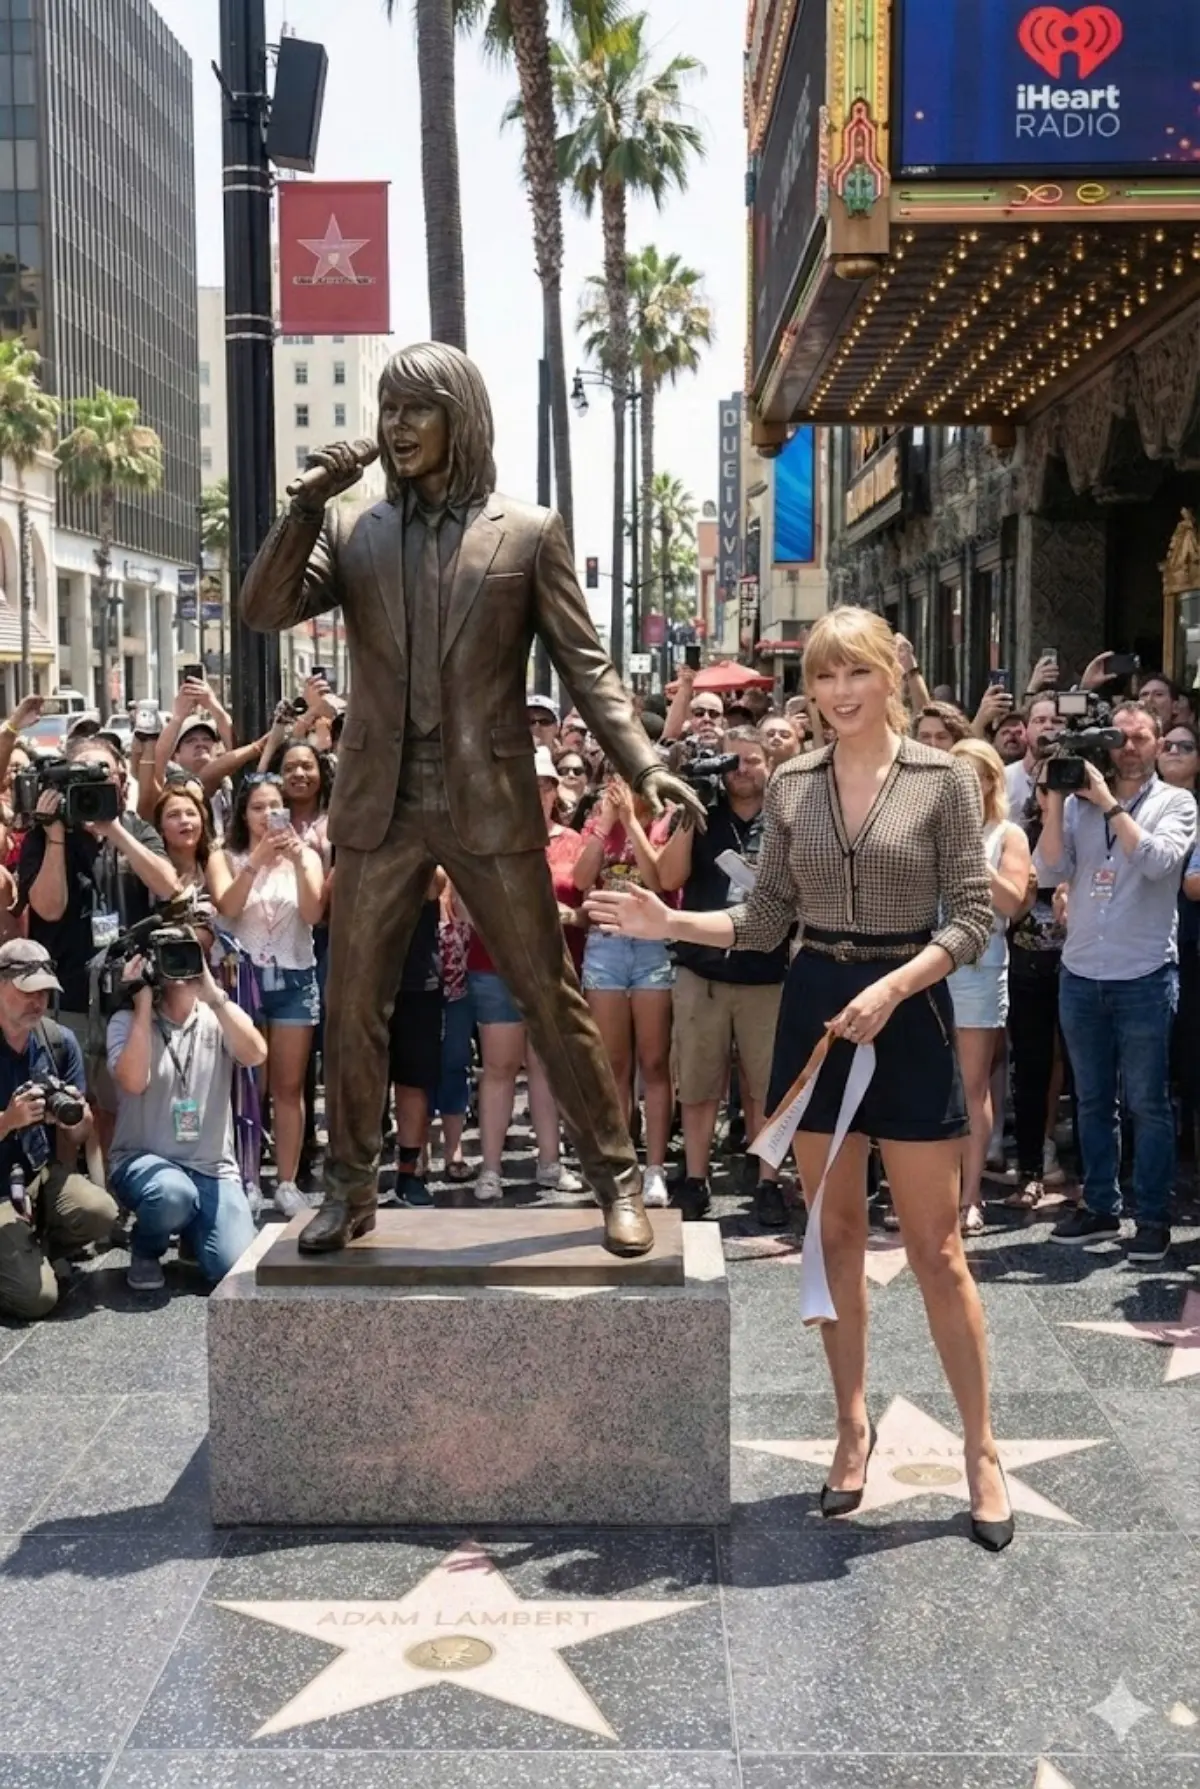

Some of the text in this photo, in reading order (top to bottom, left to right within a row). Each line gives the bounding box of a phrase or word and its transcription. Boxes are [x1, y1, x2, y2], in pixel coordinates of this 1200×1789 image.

[1017, 84, 1120, 110] iHeart
[1015, 112, 1120, 138] RADIO
[316, 1611, 598, 1627] ADAM LAMBERT
